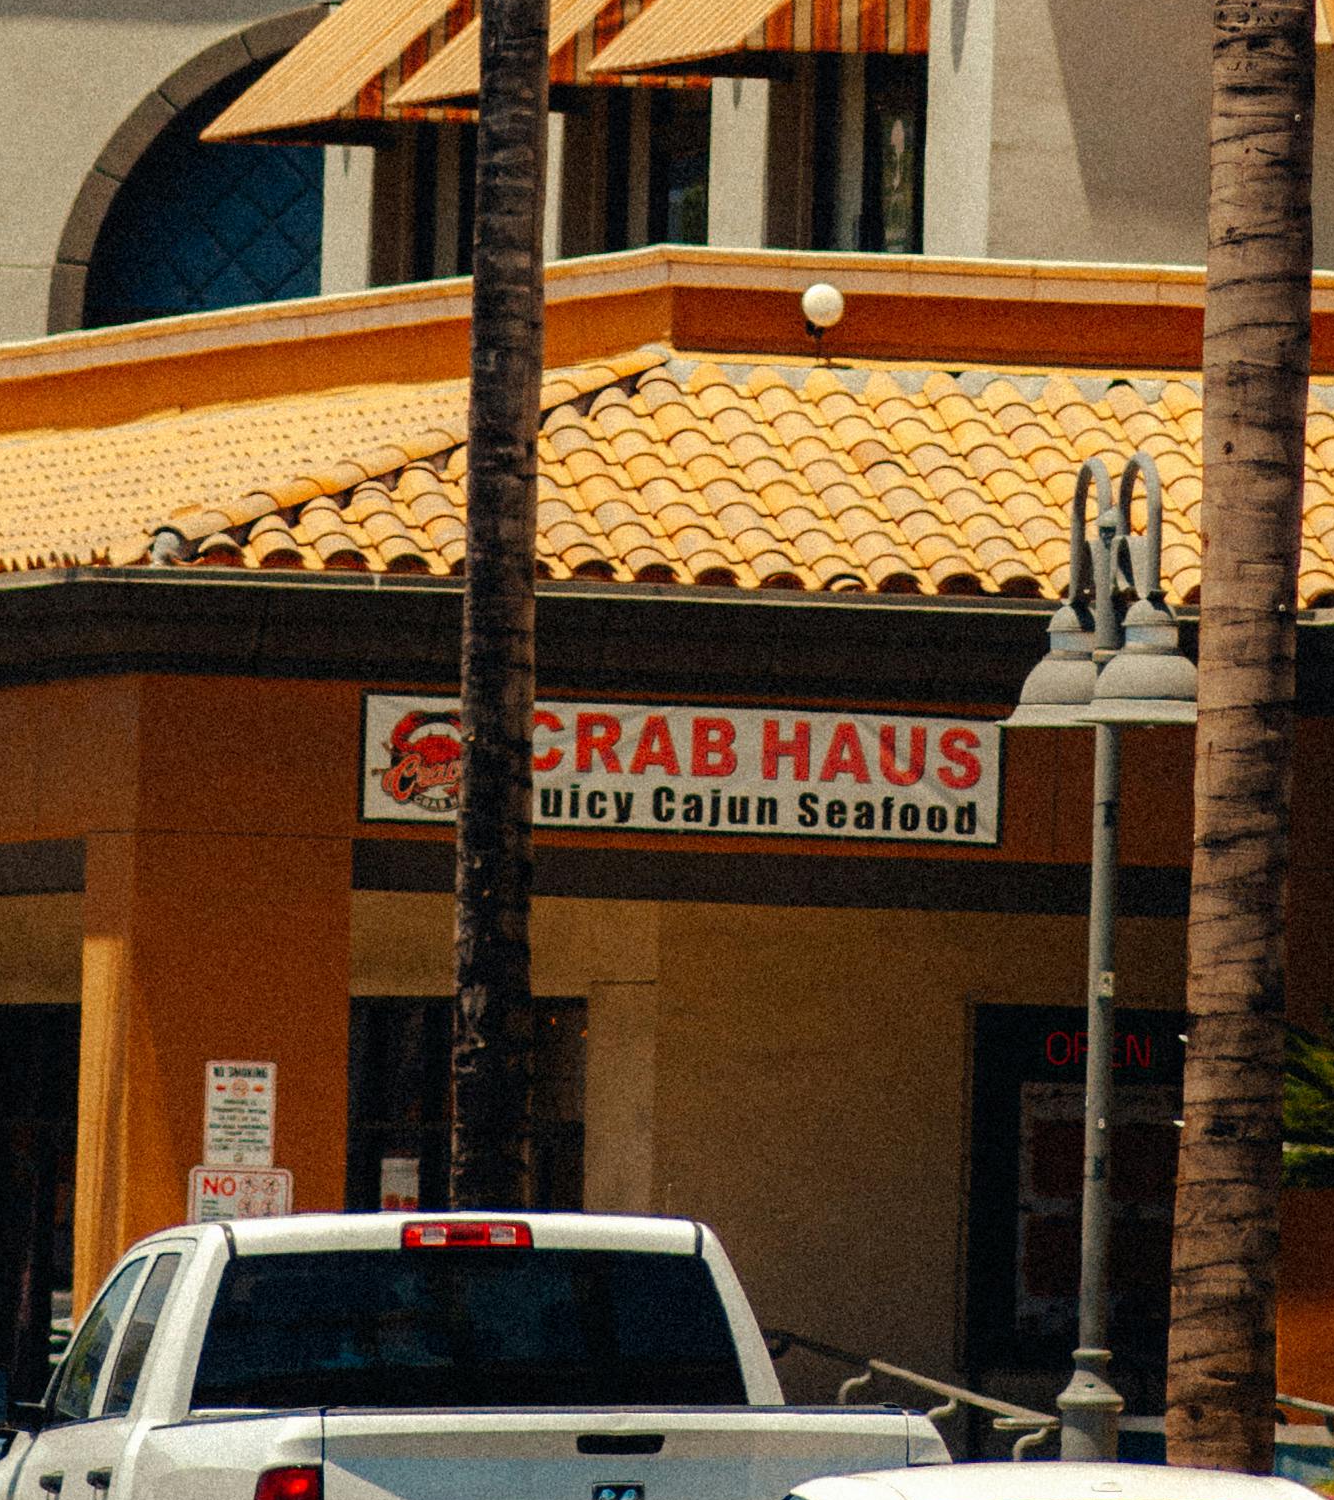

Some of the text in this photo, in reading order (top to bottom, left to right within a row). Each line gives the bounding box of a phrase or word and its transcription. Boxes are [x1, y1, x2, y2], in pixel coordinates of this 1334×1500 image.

[532, 710, 982, 790] CRAB HAUS
[540, 784, 977, 835] uicy Cajun Seafood
[202, 1175, 236, 1197] NO
